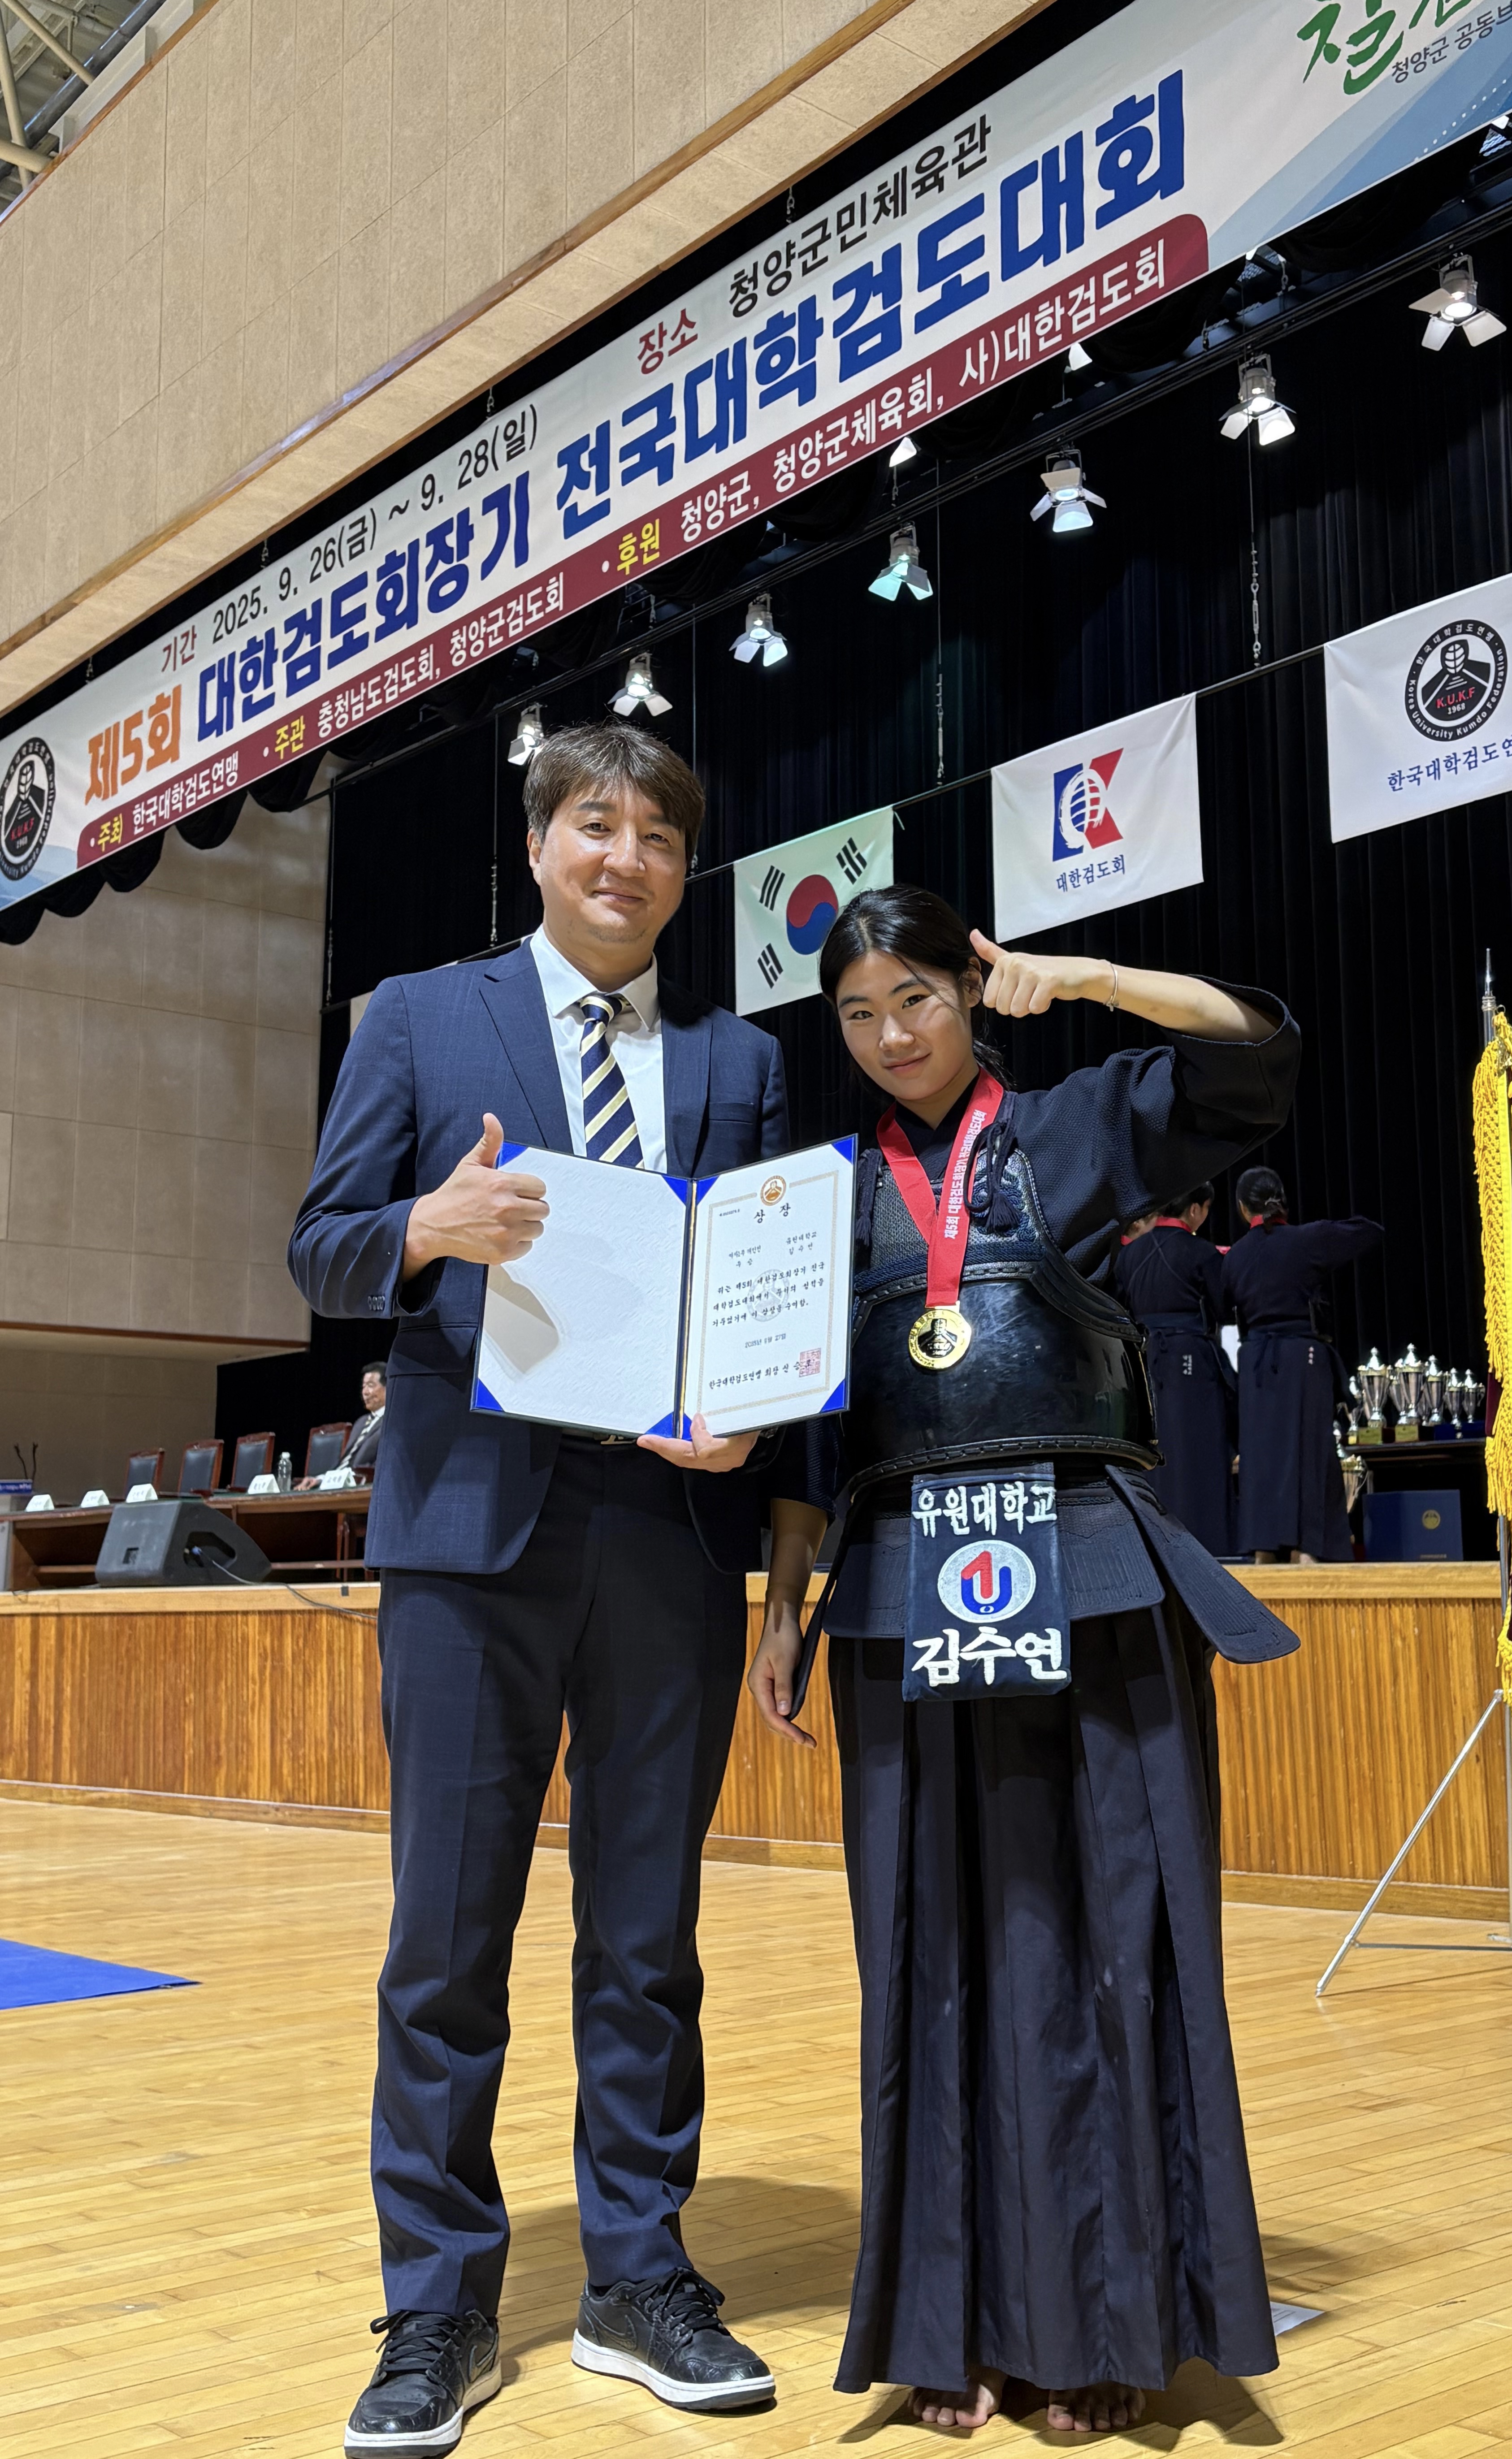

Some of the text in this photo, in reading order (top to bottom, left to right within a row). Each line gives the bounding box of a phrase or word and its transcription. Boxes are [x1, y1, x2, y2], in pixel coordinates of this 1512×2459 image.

[1391, 37, 1449, 83] 청양군
[637, 113, 992, 375] 장소 청양군민체육관
[84, 69, 1185, 806] 제5회 대한검도회장기 전국대학검도대회
[97, 813, 123, 853] 주최
[132, 750, 239, 836] 한국대학검도연맹
[274, 715, 306, 760] 주관
[317, 643, 442, 739] 충청남도검도회,
[449, 571, 563, 668] 청양군검도회
[616, 518, 660, 576] 후원
[680, 470, 760, 543] 청양군,
[773, 367, 944, 493] 청양군체육회,
[958, 238, 1165, 388] 사)대한검도회
[161, 624, 198, 673] 기간
[212, 585, 268, 644] 2025.
[278, 567, 298, 602] 9.
[309, 507, 377, 584] 26(금)
[420, 473, 444, 511] 9.
[457, 403, 537, 490] 28(일)
[1435, 686, 1476, 709] K.U.K.F
[1447, 702, 1466, 715] 1968
[1486, 648, 1505, 709] Federation
[1408, 679, 1487, 740] Korea University Kumdo
[1056, 854, 1126, 893] 대한검도회
[944, 1216, 960, 1239] 제5회
[912, 1481, 1057, 1538] 유원대학교
[910, 1626, 1068, 1687] 김수연
